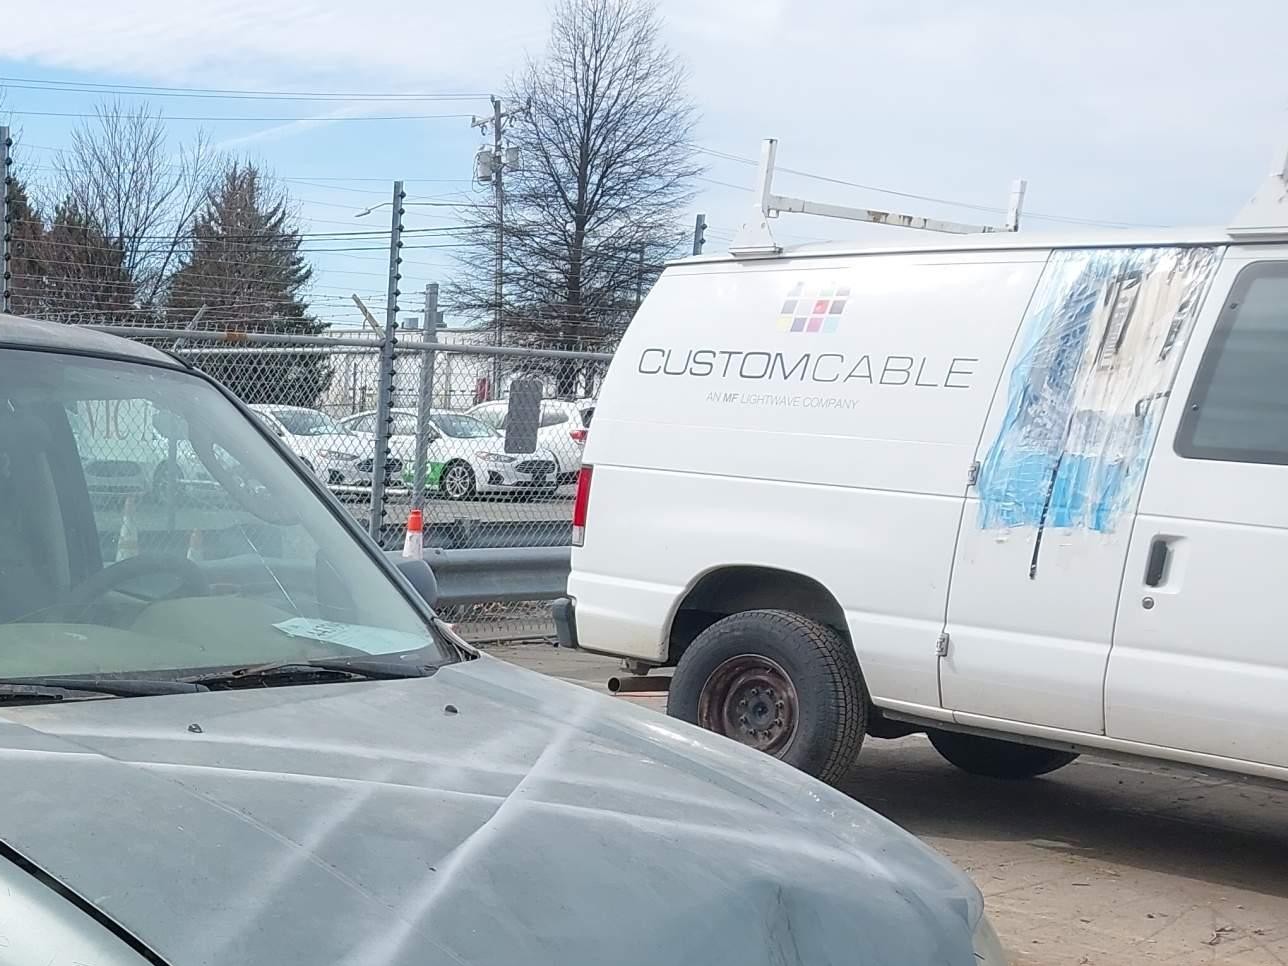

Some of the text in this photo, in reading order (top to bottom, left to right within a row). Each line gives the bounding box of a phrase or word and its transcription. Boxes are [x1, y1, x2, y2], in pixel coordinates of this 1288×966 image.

[638, 349, 979, 389] CUSTOMCABLE
[740, 393, 800, 407] LIGHTWAVE
[802, 396, 859, 409] COMPANY
